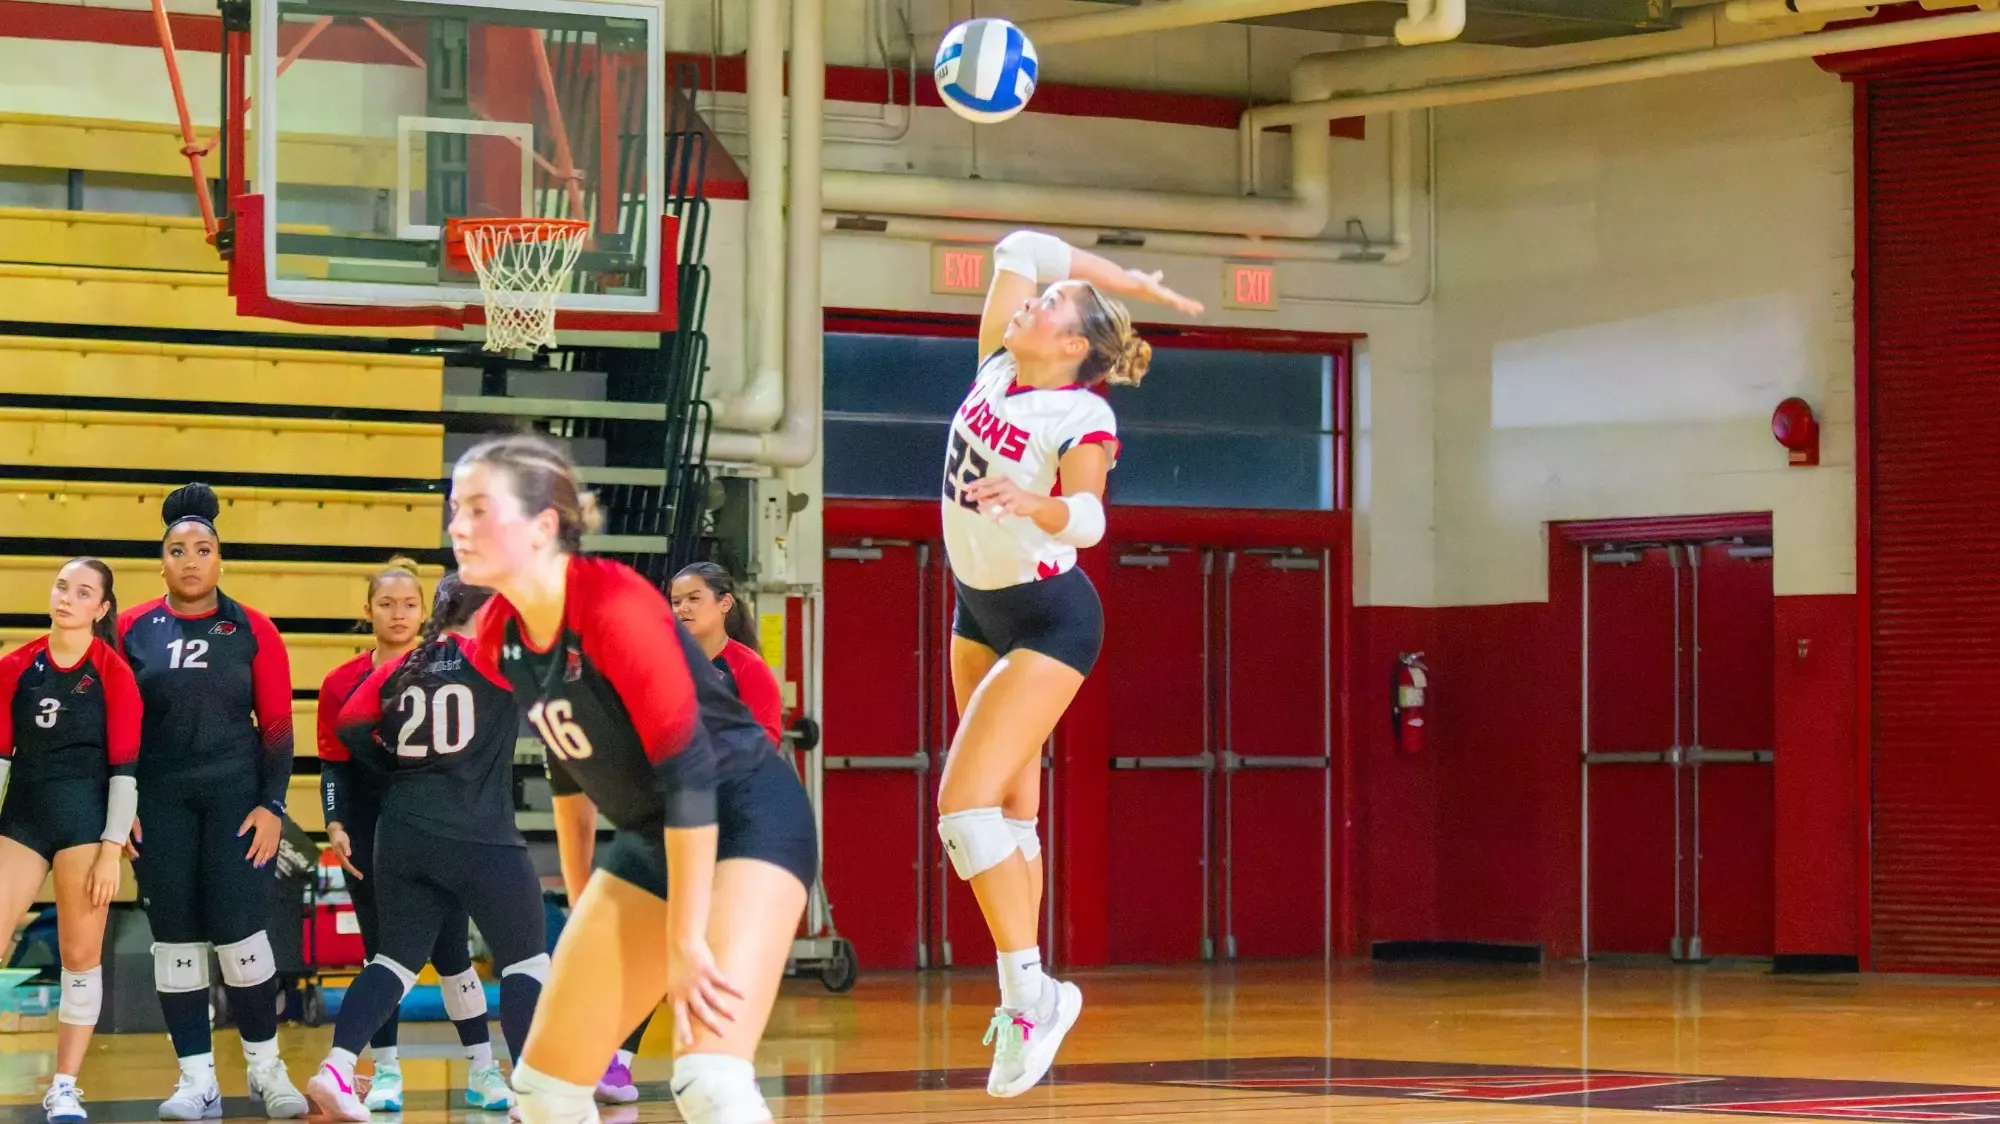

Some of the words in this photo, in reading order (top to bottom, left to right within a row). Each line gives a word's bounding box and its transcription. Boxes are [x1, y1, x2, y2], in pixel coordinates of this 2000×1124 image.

[944, 253, 983, 288] EXIT
[1235, 269, 1273, 304] EXIT
[961, 398, 1031, 463] IONS
[167, 638, 209, 669] 12
[35, 697, 61, 729] 3
[397, 684, 475, 757] 20
[527, 699, 593, 760] 16
[326, 782, 336, 811] LIONS
